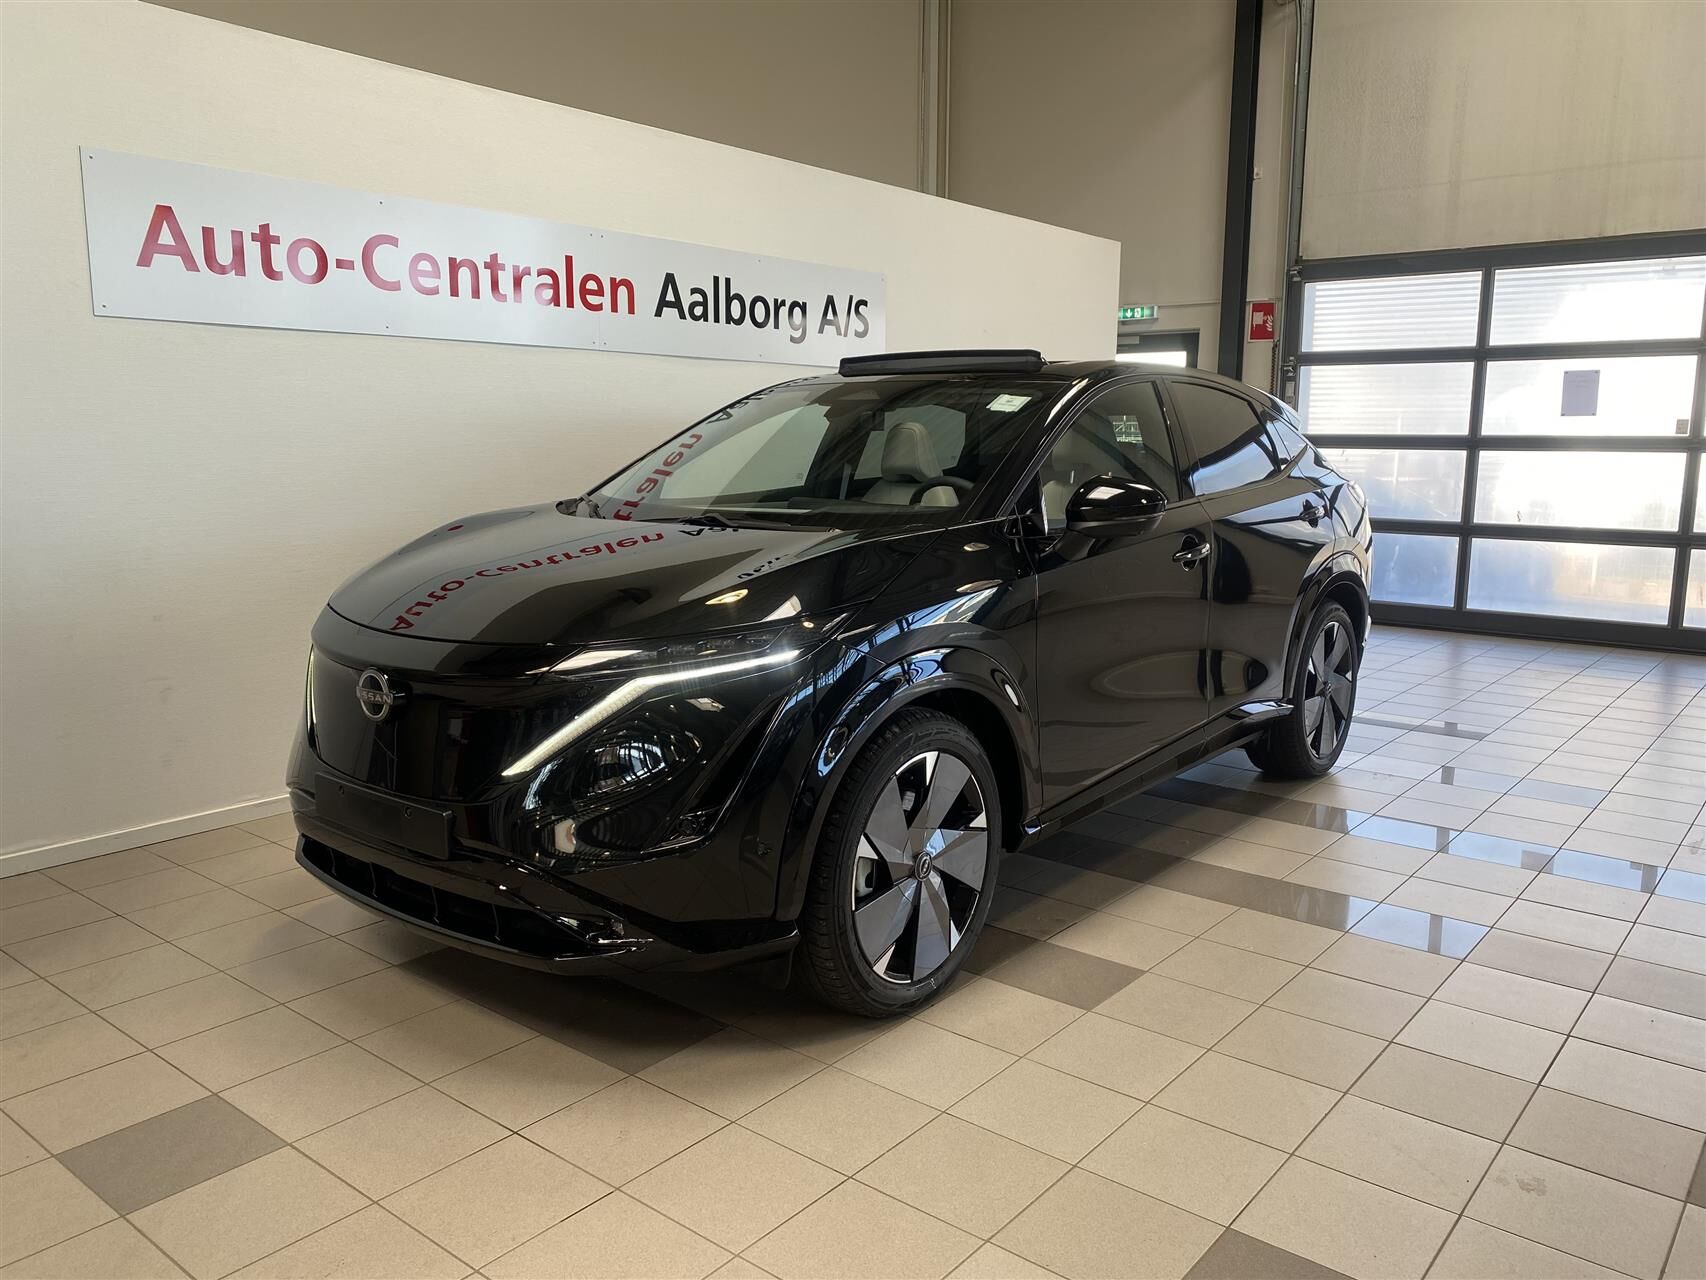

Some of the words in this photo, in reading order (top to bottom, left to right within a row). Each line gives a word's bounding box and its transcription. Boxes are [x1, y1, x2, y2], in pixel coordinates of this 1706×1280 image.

[136, 203, 637, 317] Auto-Centralen
[653, 271, 808, 344] Aalborg
[817, 294, 870, 339] A/S
